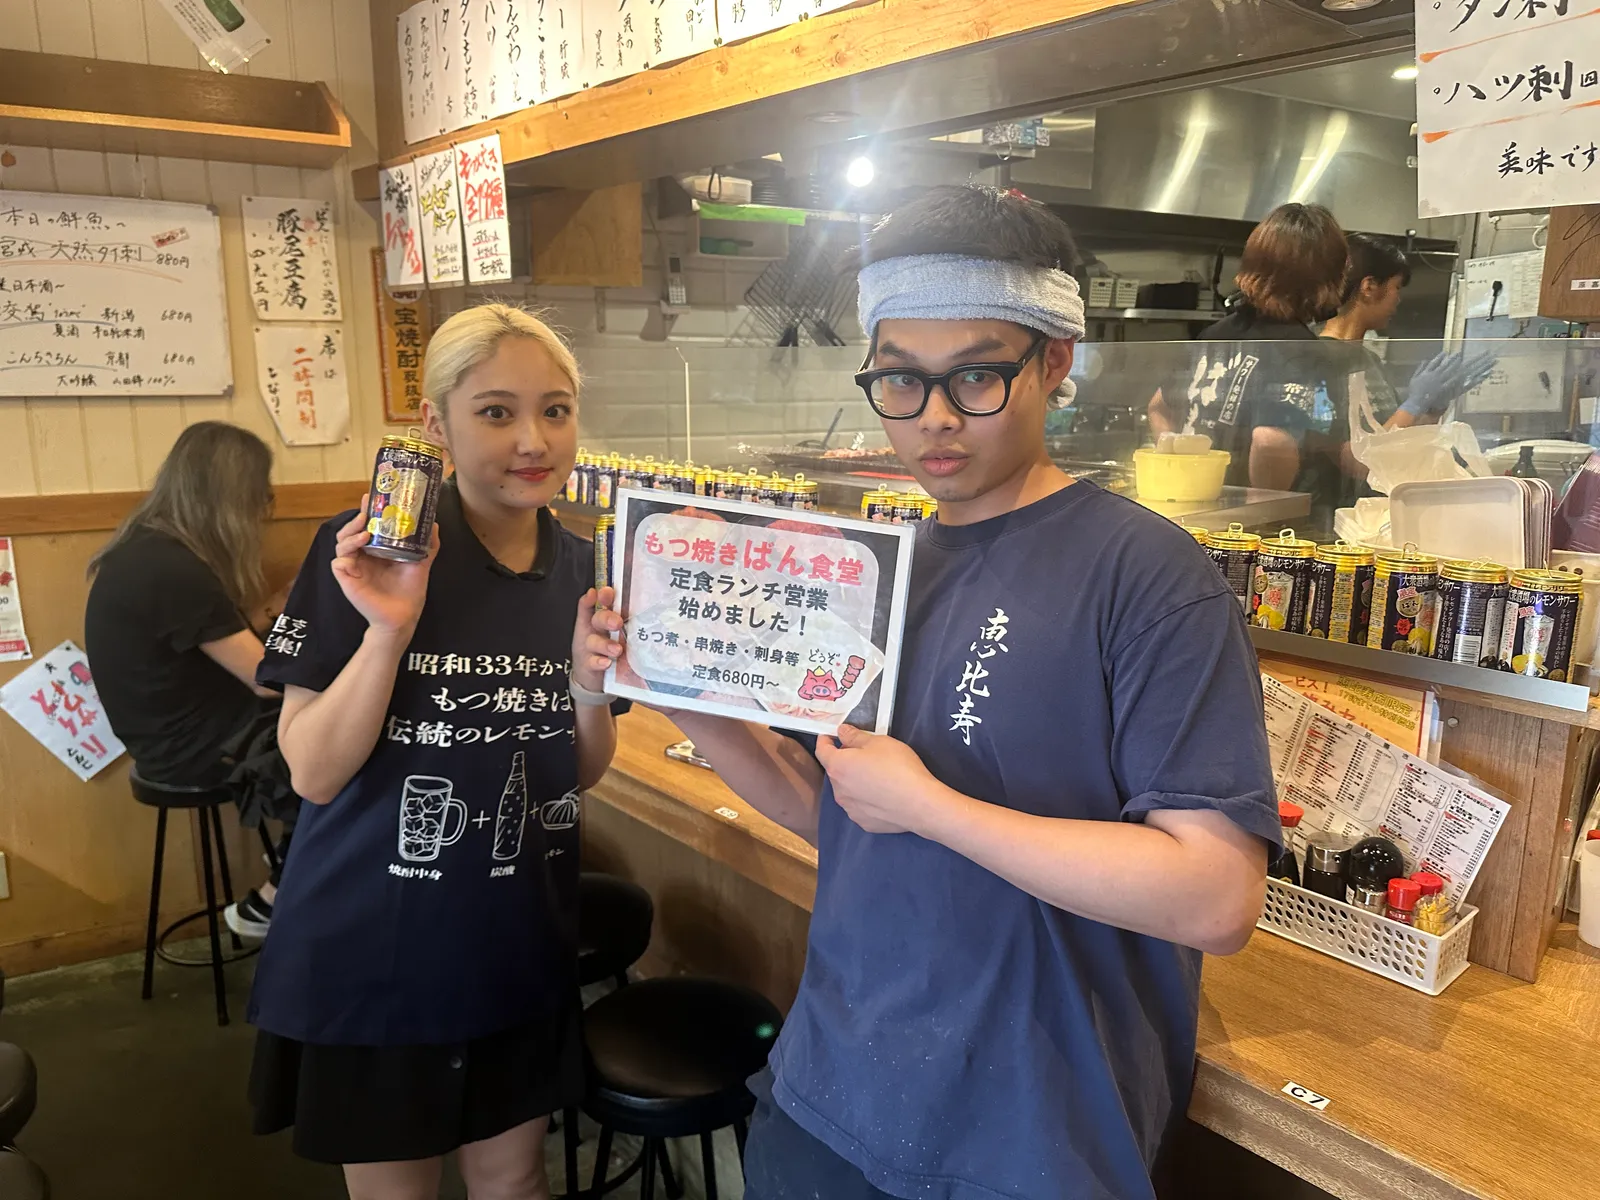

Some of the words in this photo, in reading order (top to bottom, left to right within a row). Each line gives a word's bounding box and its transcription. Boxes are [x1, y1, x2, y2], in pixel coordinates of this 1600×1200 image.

[1444, 60, 1573, 105] ハツ刺
[156, 253, 190, 269] 880円
[644, 532, 864, 587] もつ焼きばん食堂
[669, 566, 829, 612] 定食ランチ営業
[678, 596, 806, 637] 始めました！
[637, 626, 800, 667] もつ煮・串焼き・刺身等
[808, 648, 841, 666] どうぞ
[949, 607, 1010, 746] 恵比寿
[1290, 1086, 1325, 1104] C7
